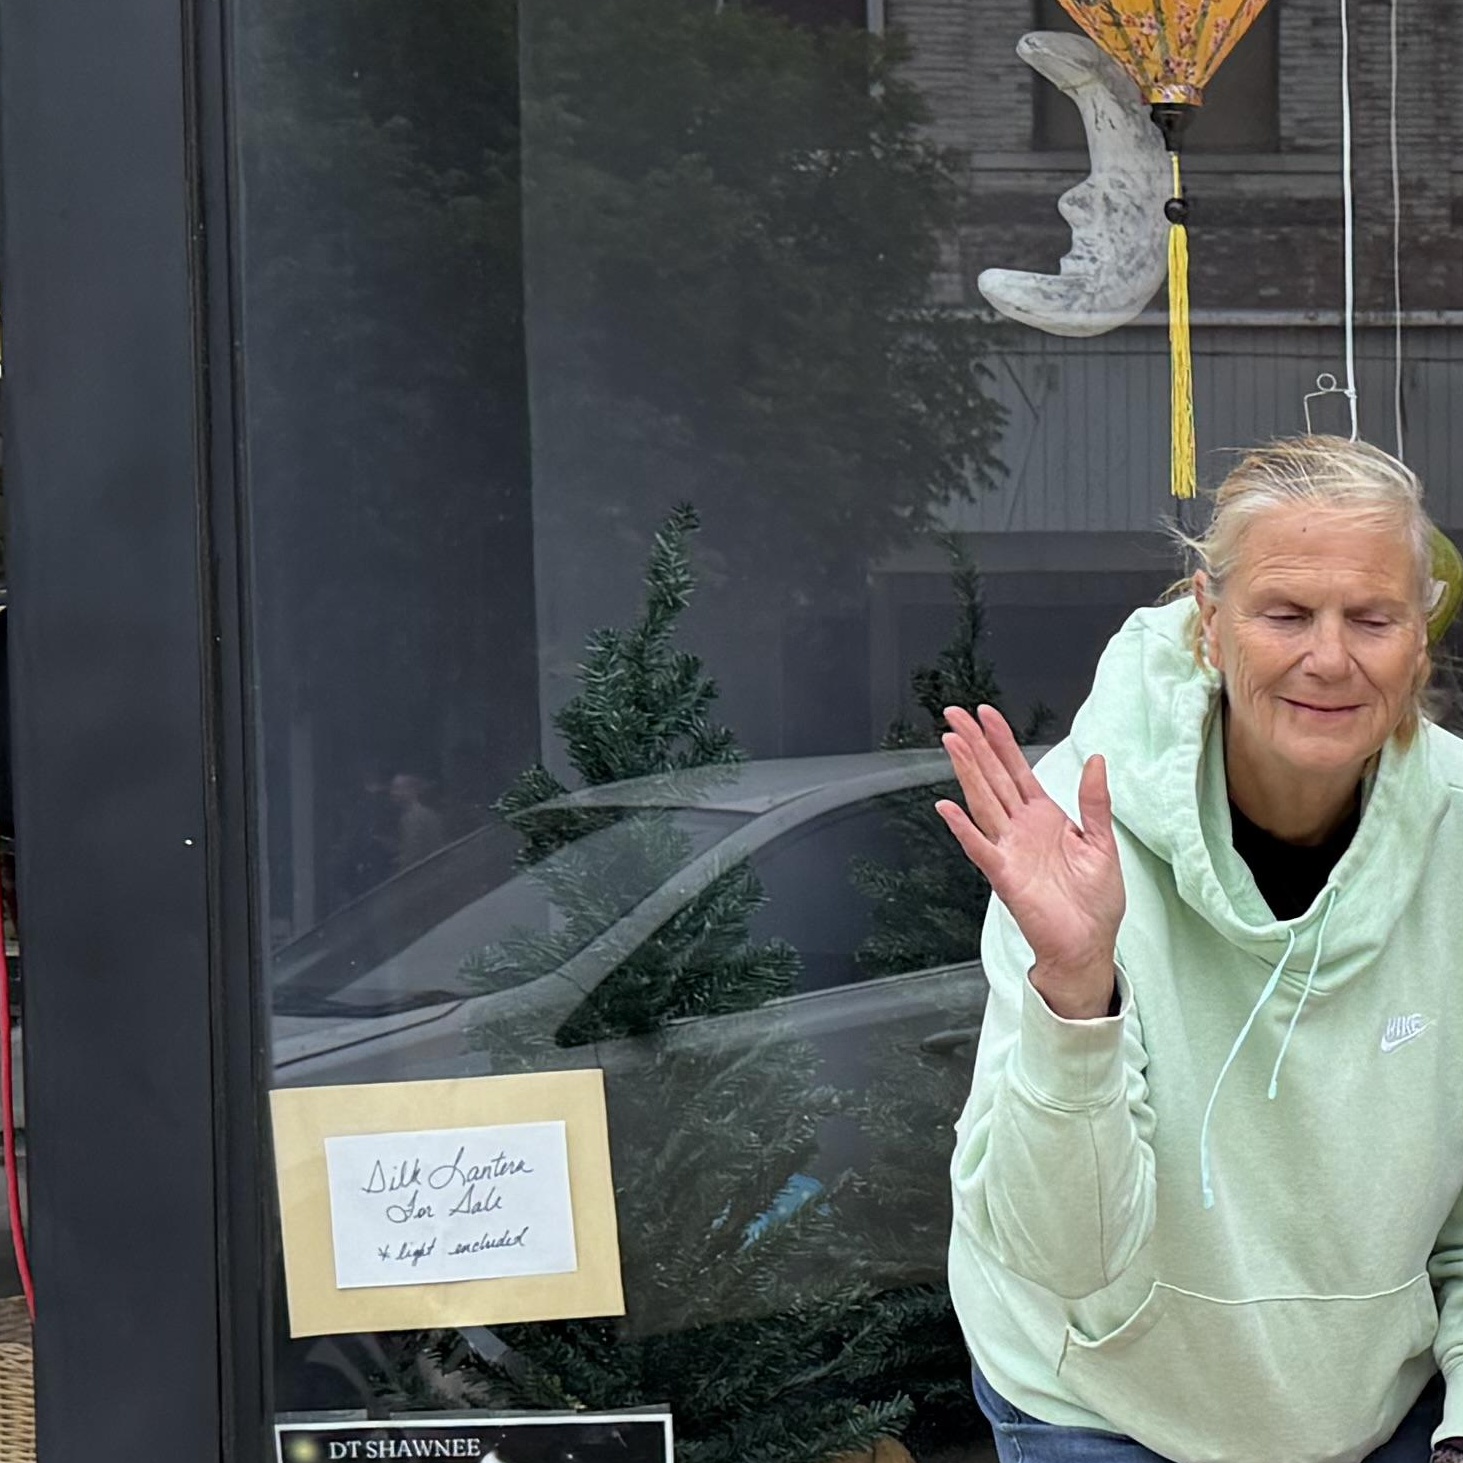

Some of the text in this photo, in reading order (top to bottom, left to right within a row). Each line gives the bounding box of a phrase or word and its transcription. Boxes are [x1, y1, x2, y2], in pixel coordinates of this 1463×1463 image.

[386, 1183, 503, 1224] For Sale
[329, 1438, 481, 1460] DT SHAWNEE
